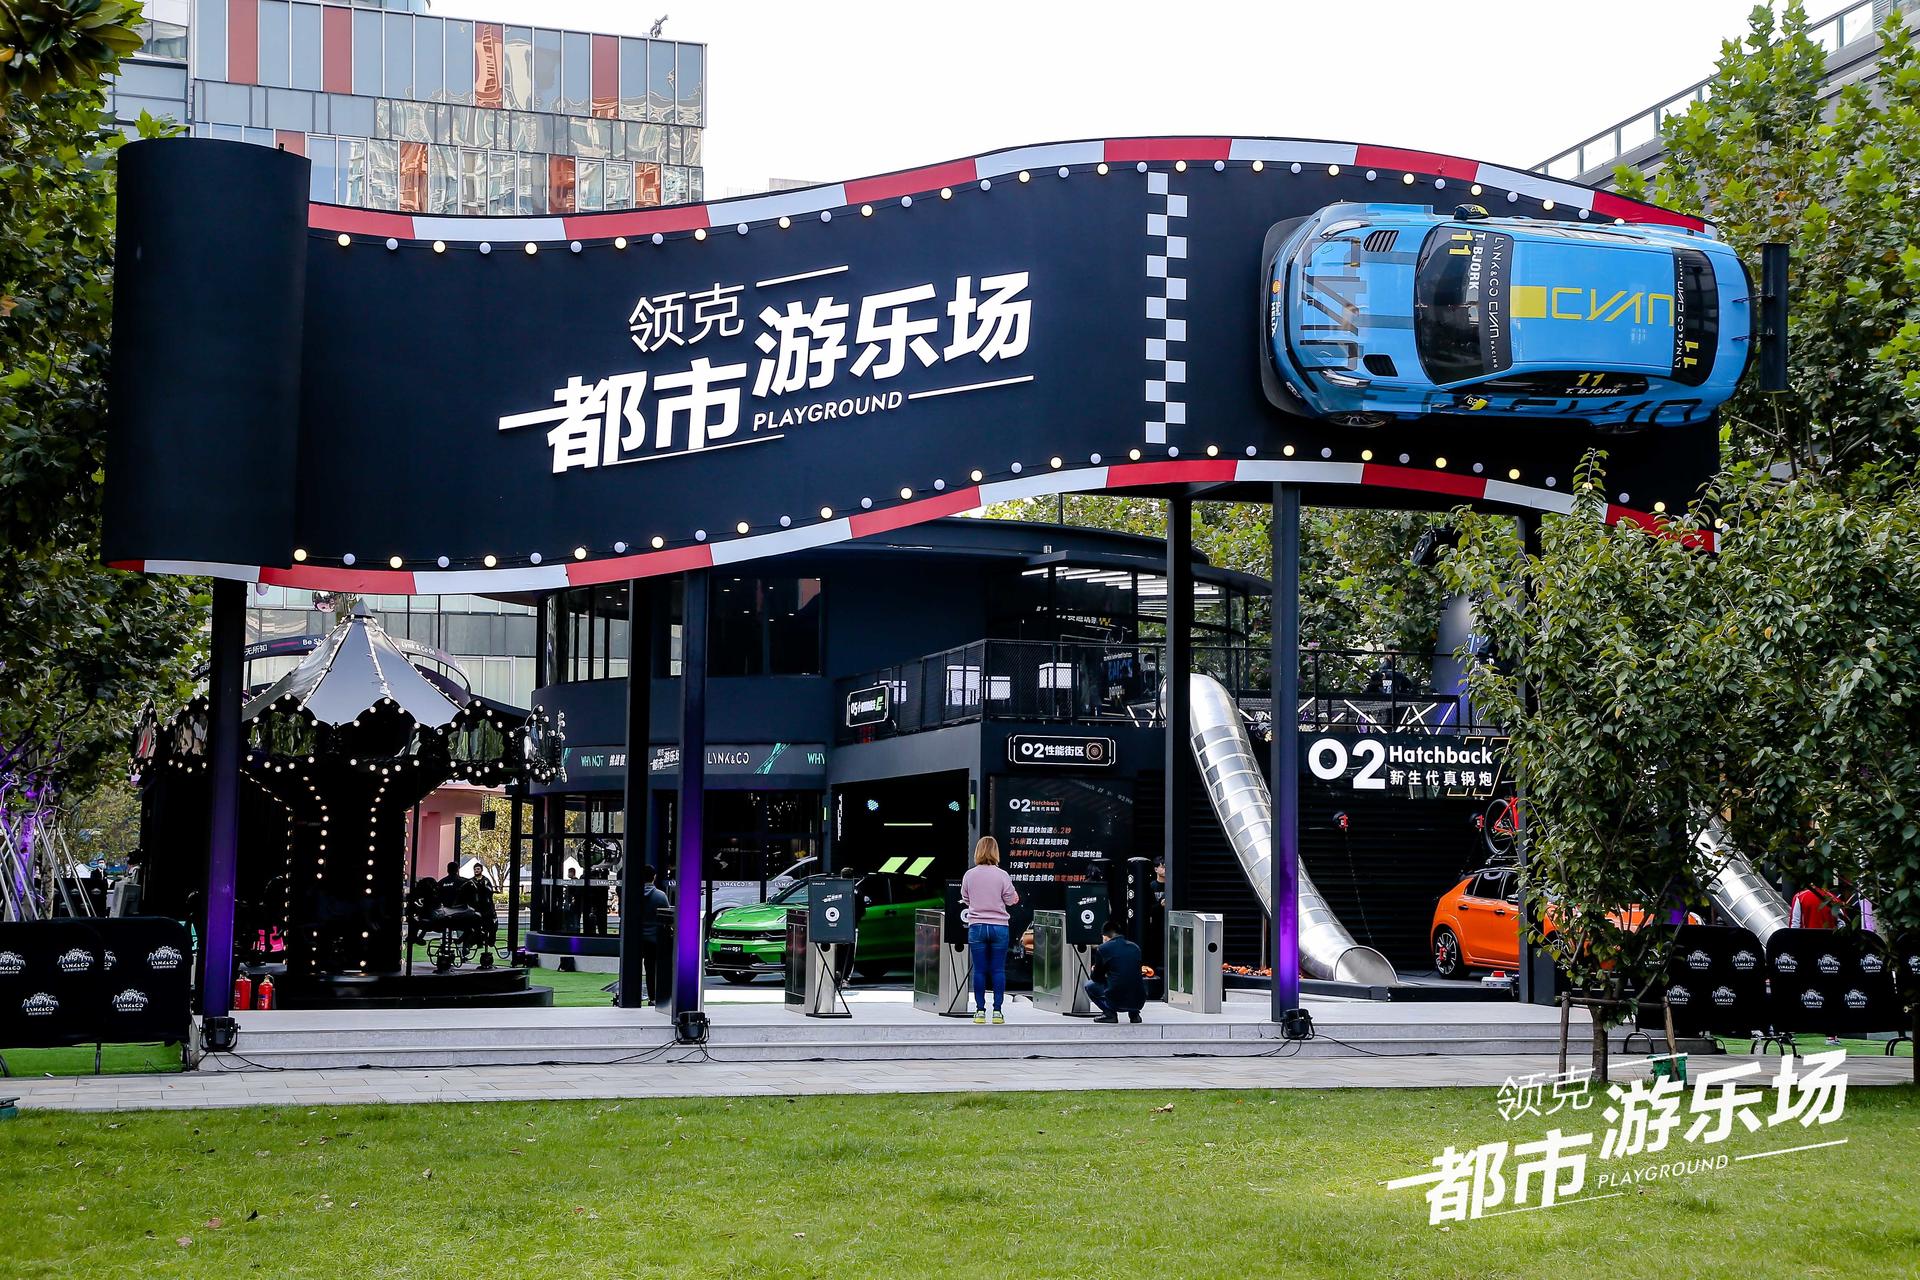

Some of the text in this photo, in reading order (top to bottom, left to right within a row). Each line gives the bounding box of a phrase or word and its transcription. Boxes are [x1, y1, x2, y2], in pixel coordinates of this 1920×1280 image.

[1449, 230, 1473, 256] 11
[629, 282, 746, 353] 领克
[752, 271, 1033, 398] 游乐场
[1576, 372, 1606, 387] 11
[499, 357, 748, 474] 都市
[753, 391, 903, 432] PLAYGROUND
[1389, 745, 1494, 764] Hatchback
[1389, 770, 1493, 787] 新生代真钢炮
